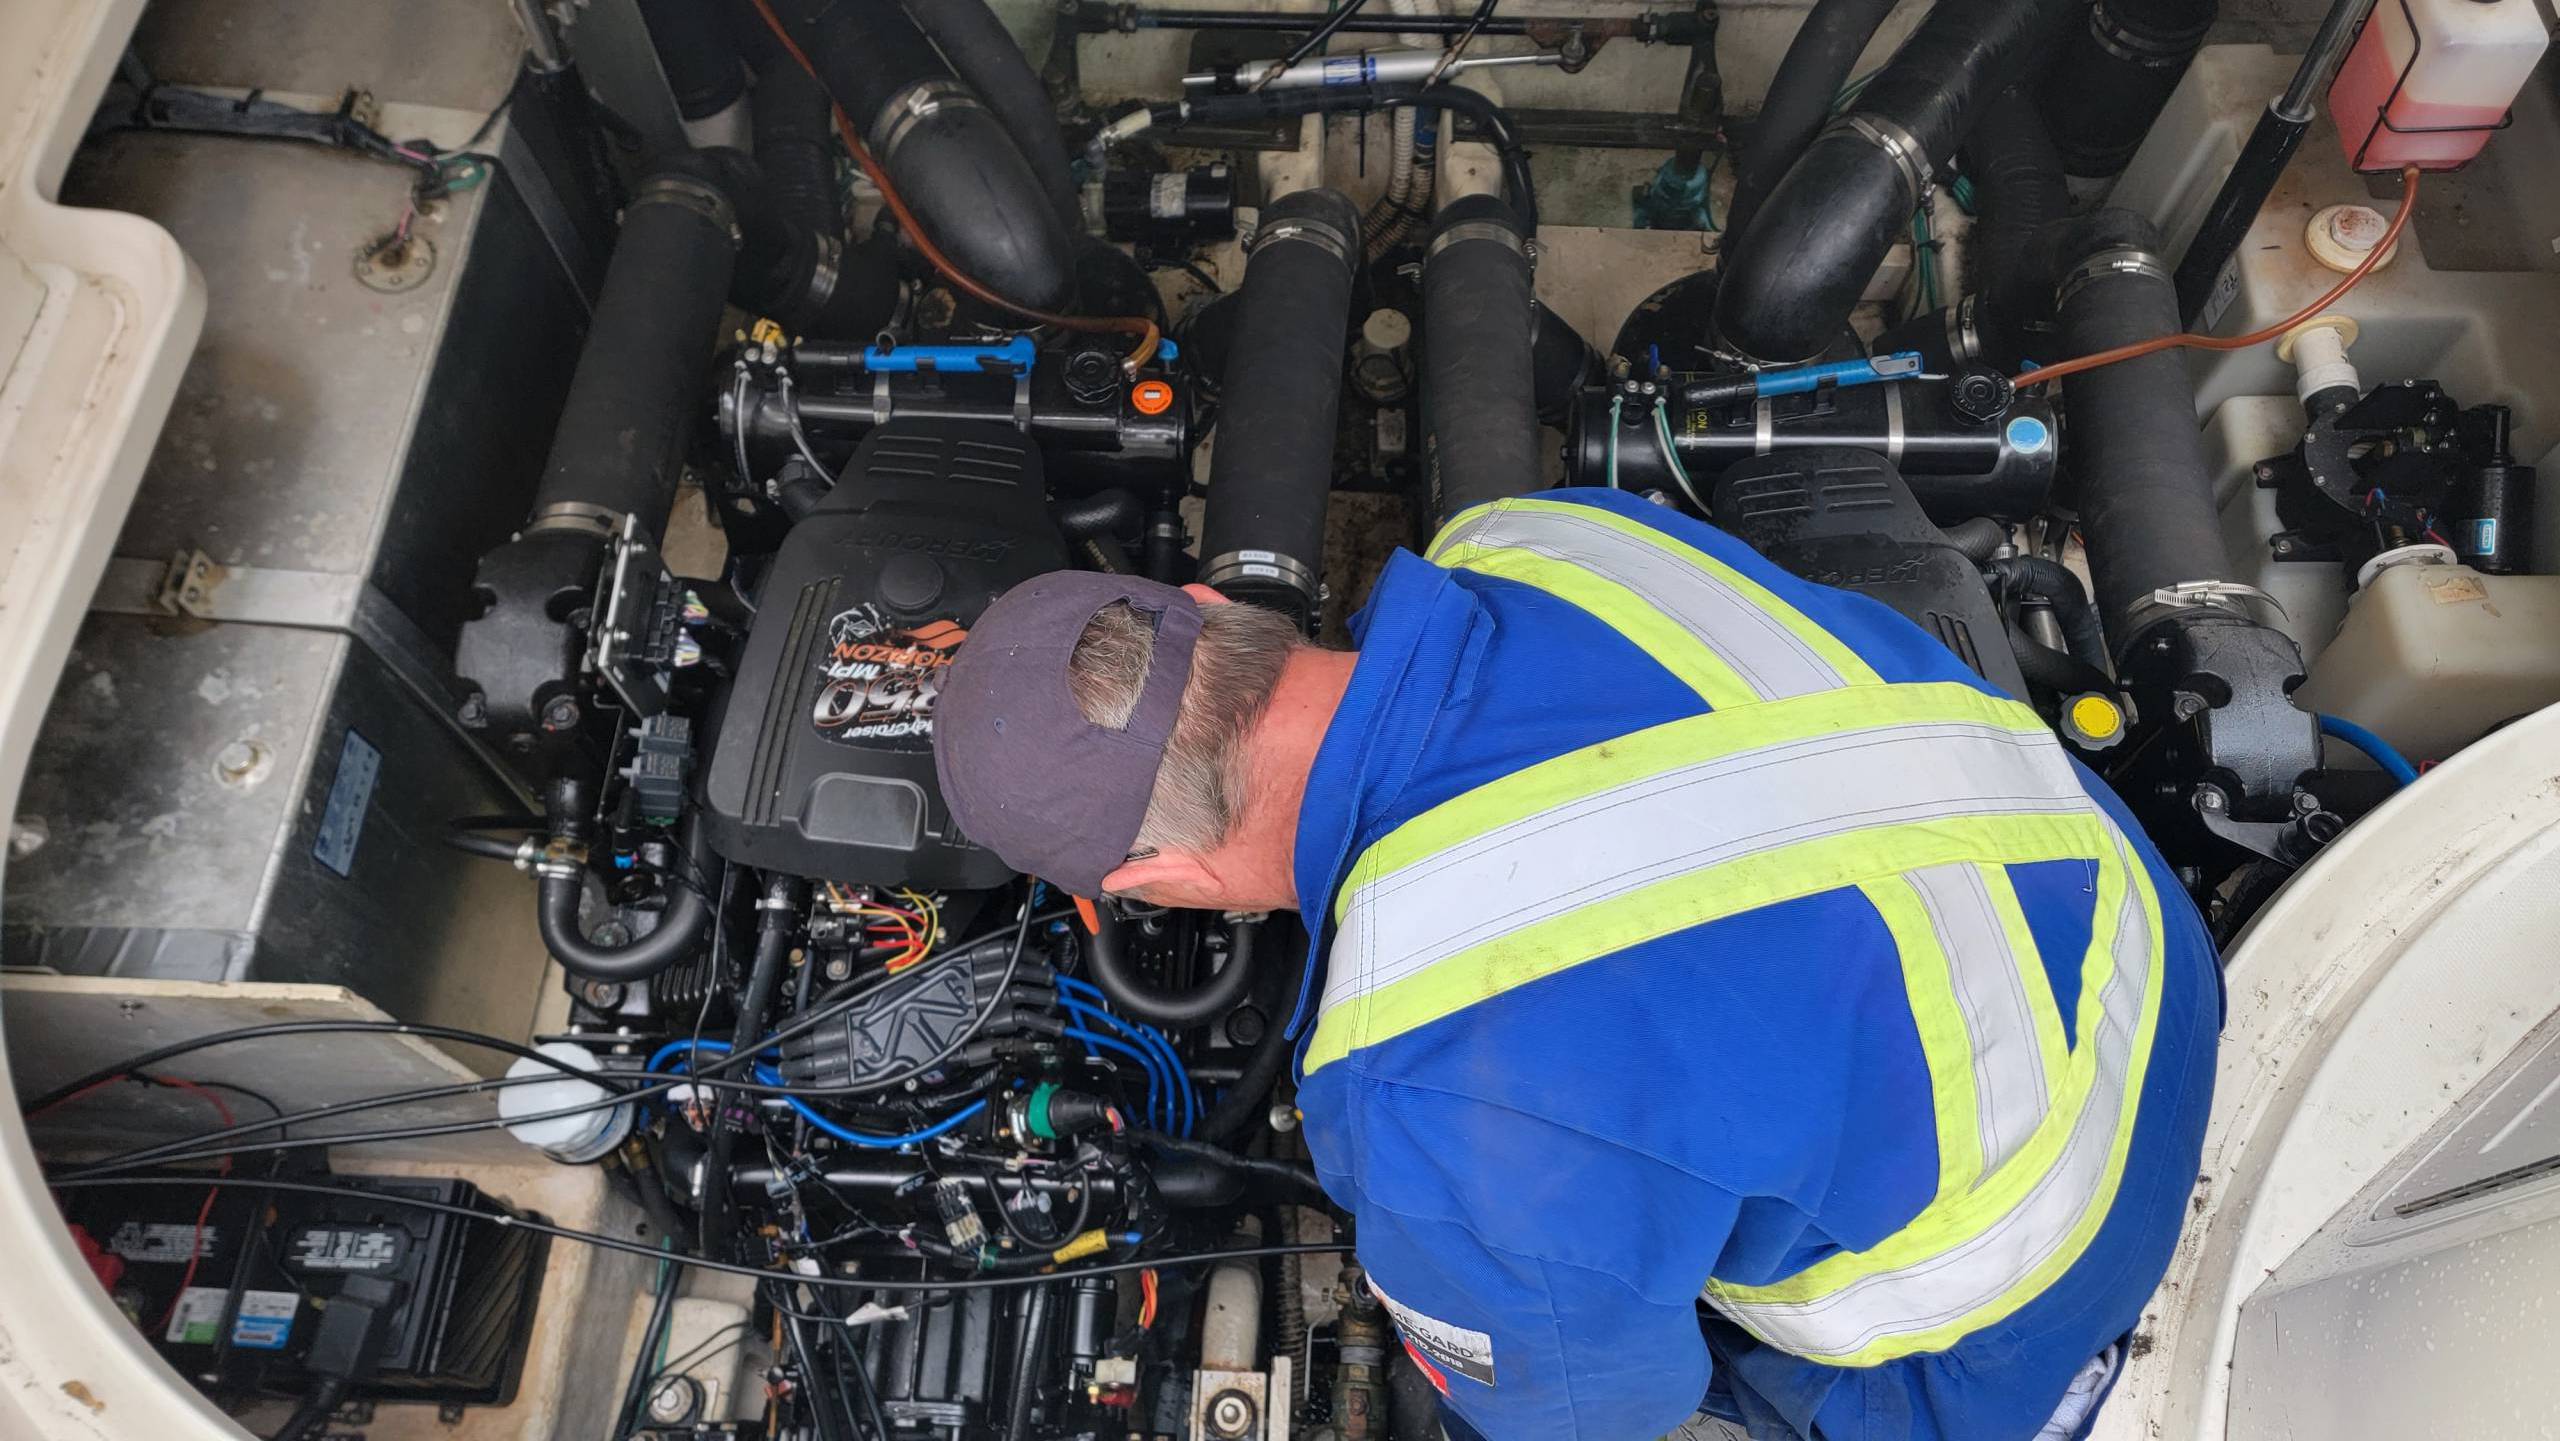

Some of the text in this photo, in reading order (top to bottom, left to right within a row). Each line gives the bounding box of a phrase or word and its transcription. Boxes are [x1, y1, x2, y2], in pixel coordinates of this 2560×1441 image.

[832, 641, 955, 668] HORIZON
[827, 661, 881, 681] MPI
[813, 668, 939, 728] 350
